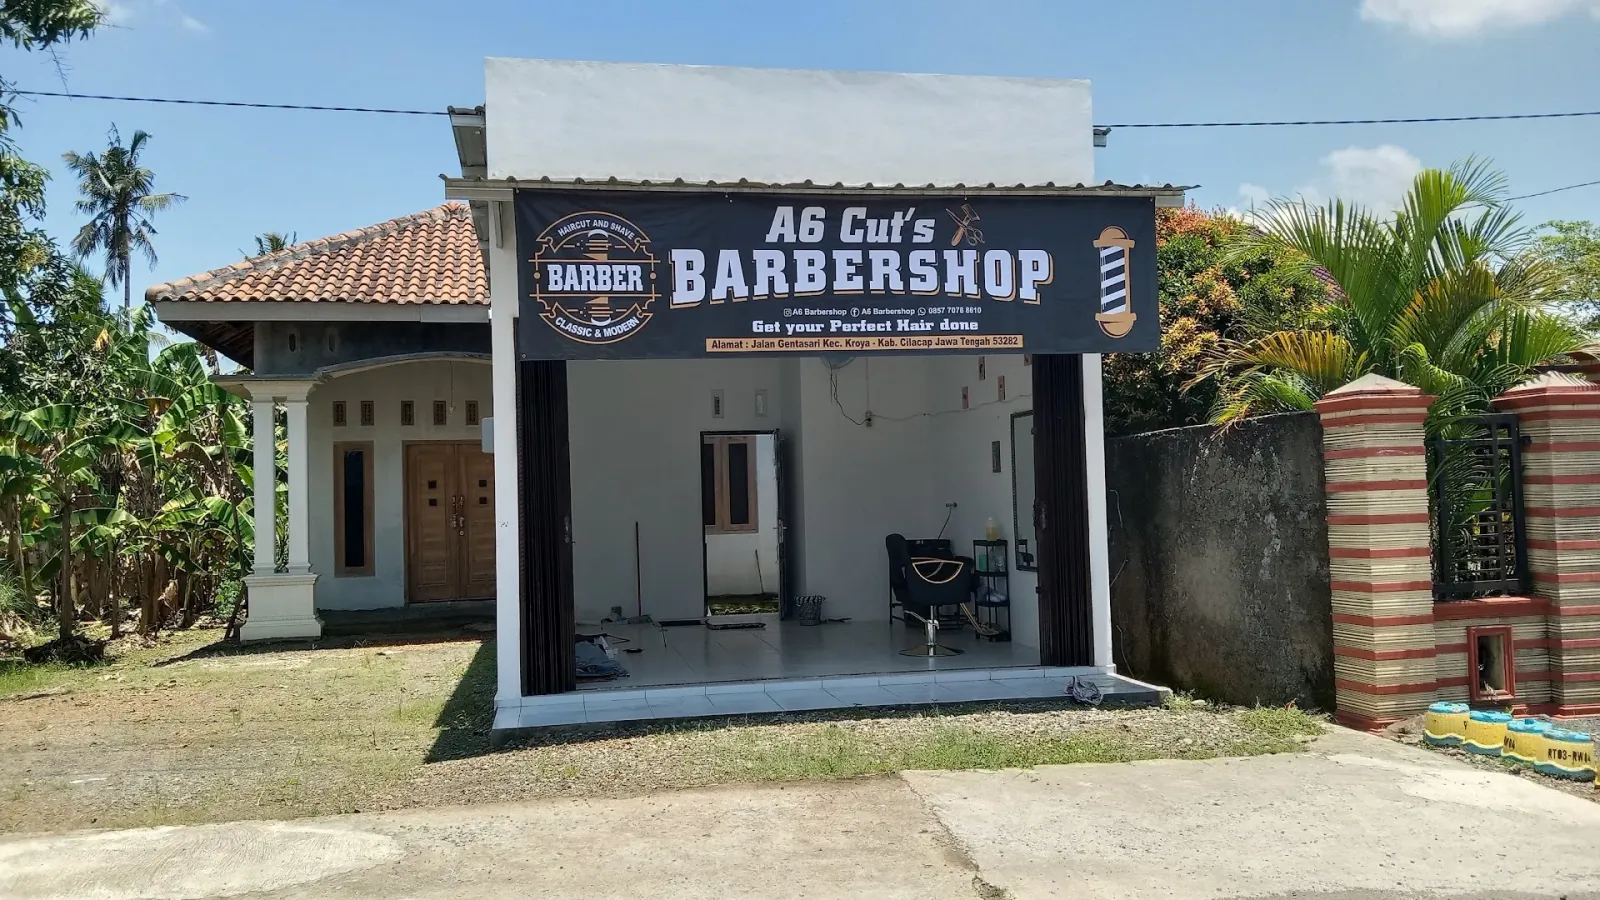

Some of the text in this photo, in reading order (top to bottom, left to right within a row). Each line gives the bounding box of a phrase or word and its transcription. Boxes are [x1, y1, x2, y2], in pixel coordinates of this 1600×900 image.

[558, 220, 635, 240] HAIRCUT AND SHAVE
[765, 206, 936, 244] A6 Cut's
[547, 264, 644, 292] BARBER
[669, 249, 1054, 309] BARBERSHOP
[792, 308, 847, 316] A6 Barbershop
[861, 307, 915, 316] A6 Barbershop
[555, 316, 640, 338] CLASSIC & MODERN
[752, 318, 979, 335] Get your Perfect Hair done
[711, 340, 743, 349] Alamat
[751, 340, 775, 349] Jalan
[777, 339, 820, 348] Gentasari
[823, 339, 843, 348] Kec.
[845, 339, 870, 349] Kroya
[878, 338, 898, 347] Kab.
[900, 337, 933, 348] Cilacap
[935, 337, 958, 346] Jawa
[960, 337, 990, 348] Tengah
[992, 336, 1018, 346] 53282
